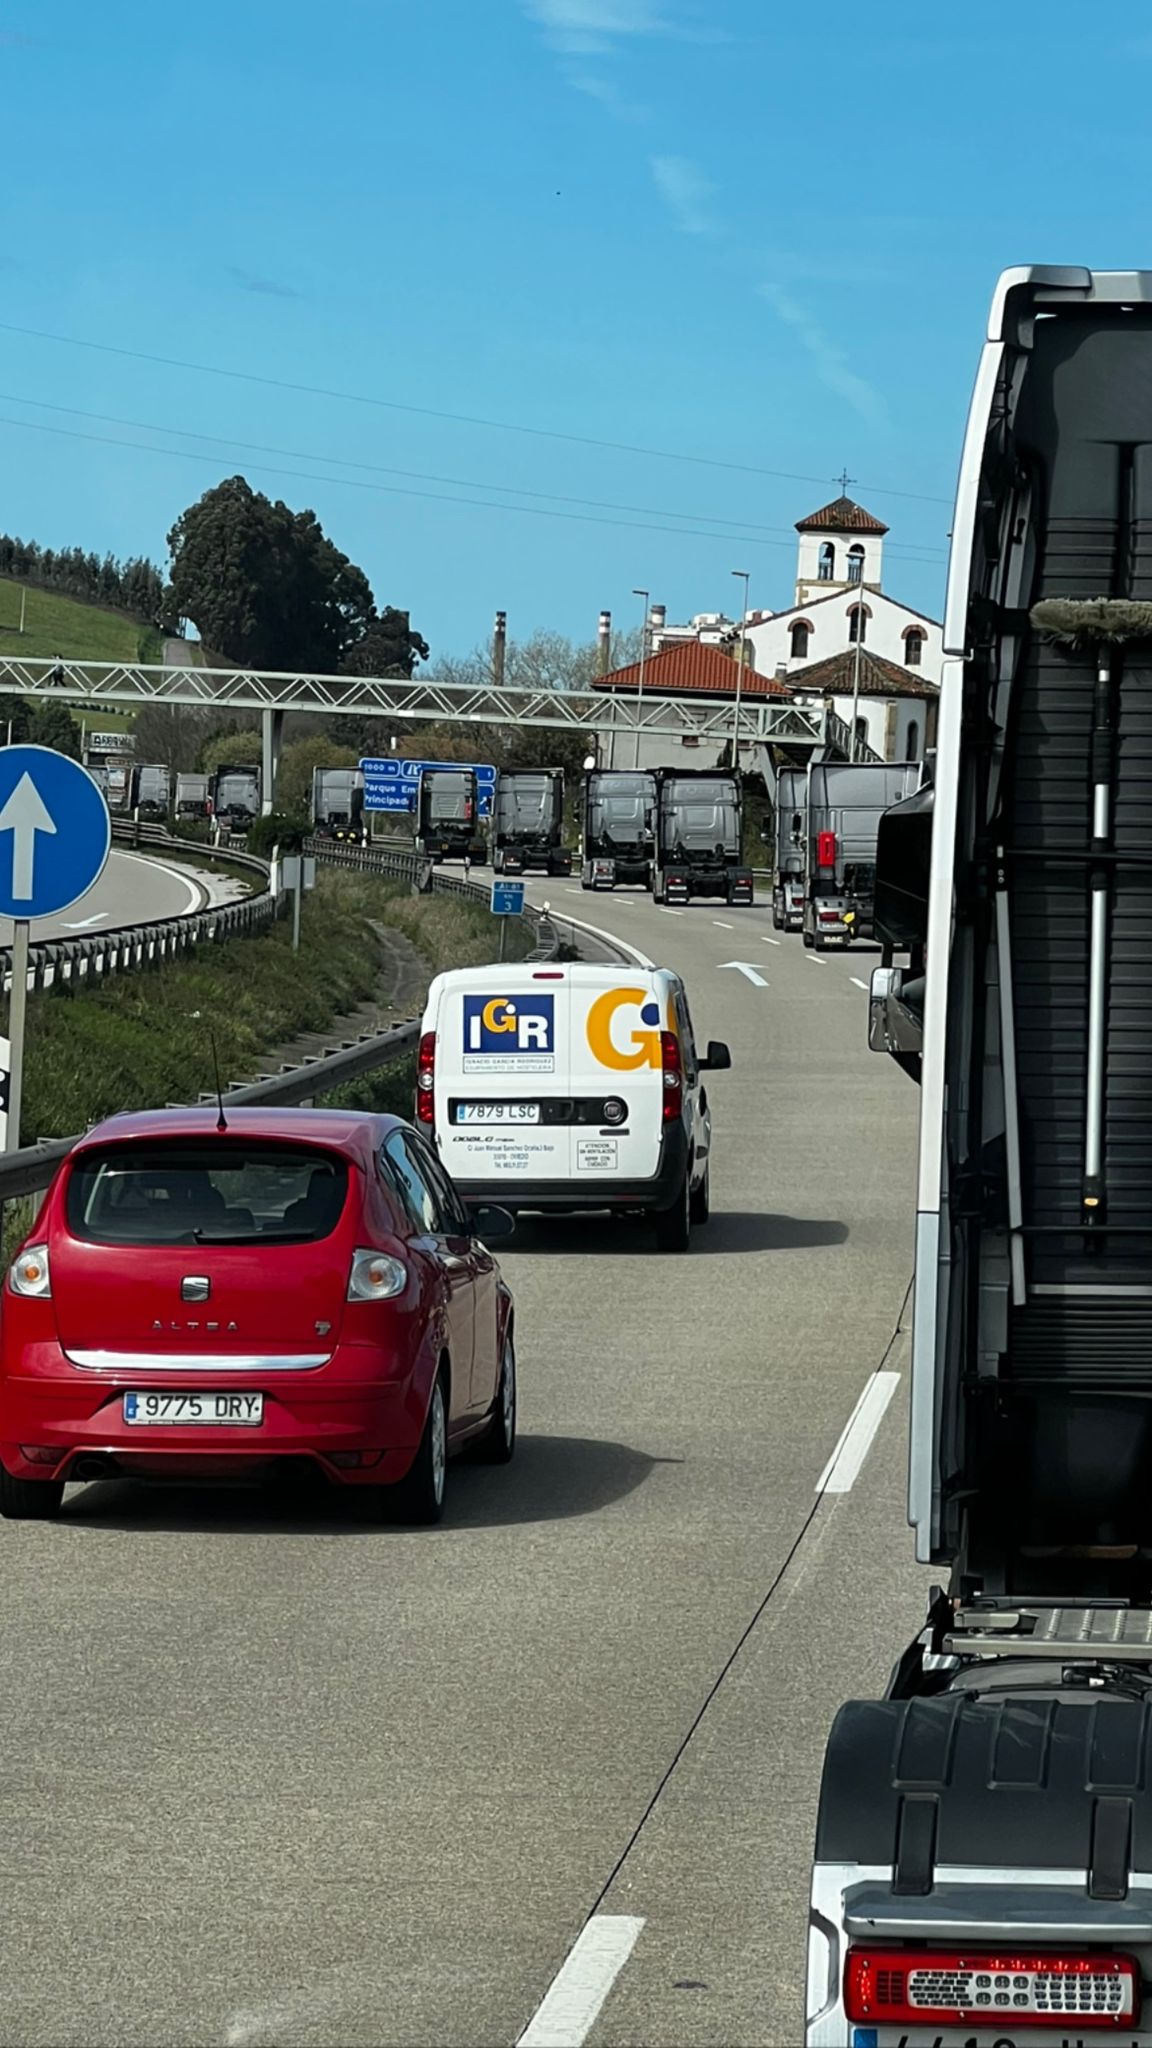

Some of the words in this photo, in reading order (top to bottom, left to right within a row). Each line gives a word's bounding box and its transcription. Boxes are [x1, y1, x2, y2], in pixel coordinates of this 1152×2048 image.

[364, 782, 396, 794] Parque
[504, 901, 512, 911] 3
[470, 998, 549, 1048] IGR
[468, 1105, 503, 1118] 7879
[509, 1105, 536, 1118] LSC
[152, 1320, 238, 1330] ALTEA
[145, 1396, 202, 1416] 9775
[215, 1397, 257, 1417] DRY
